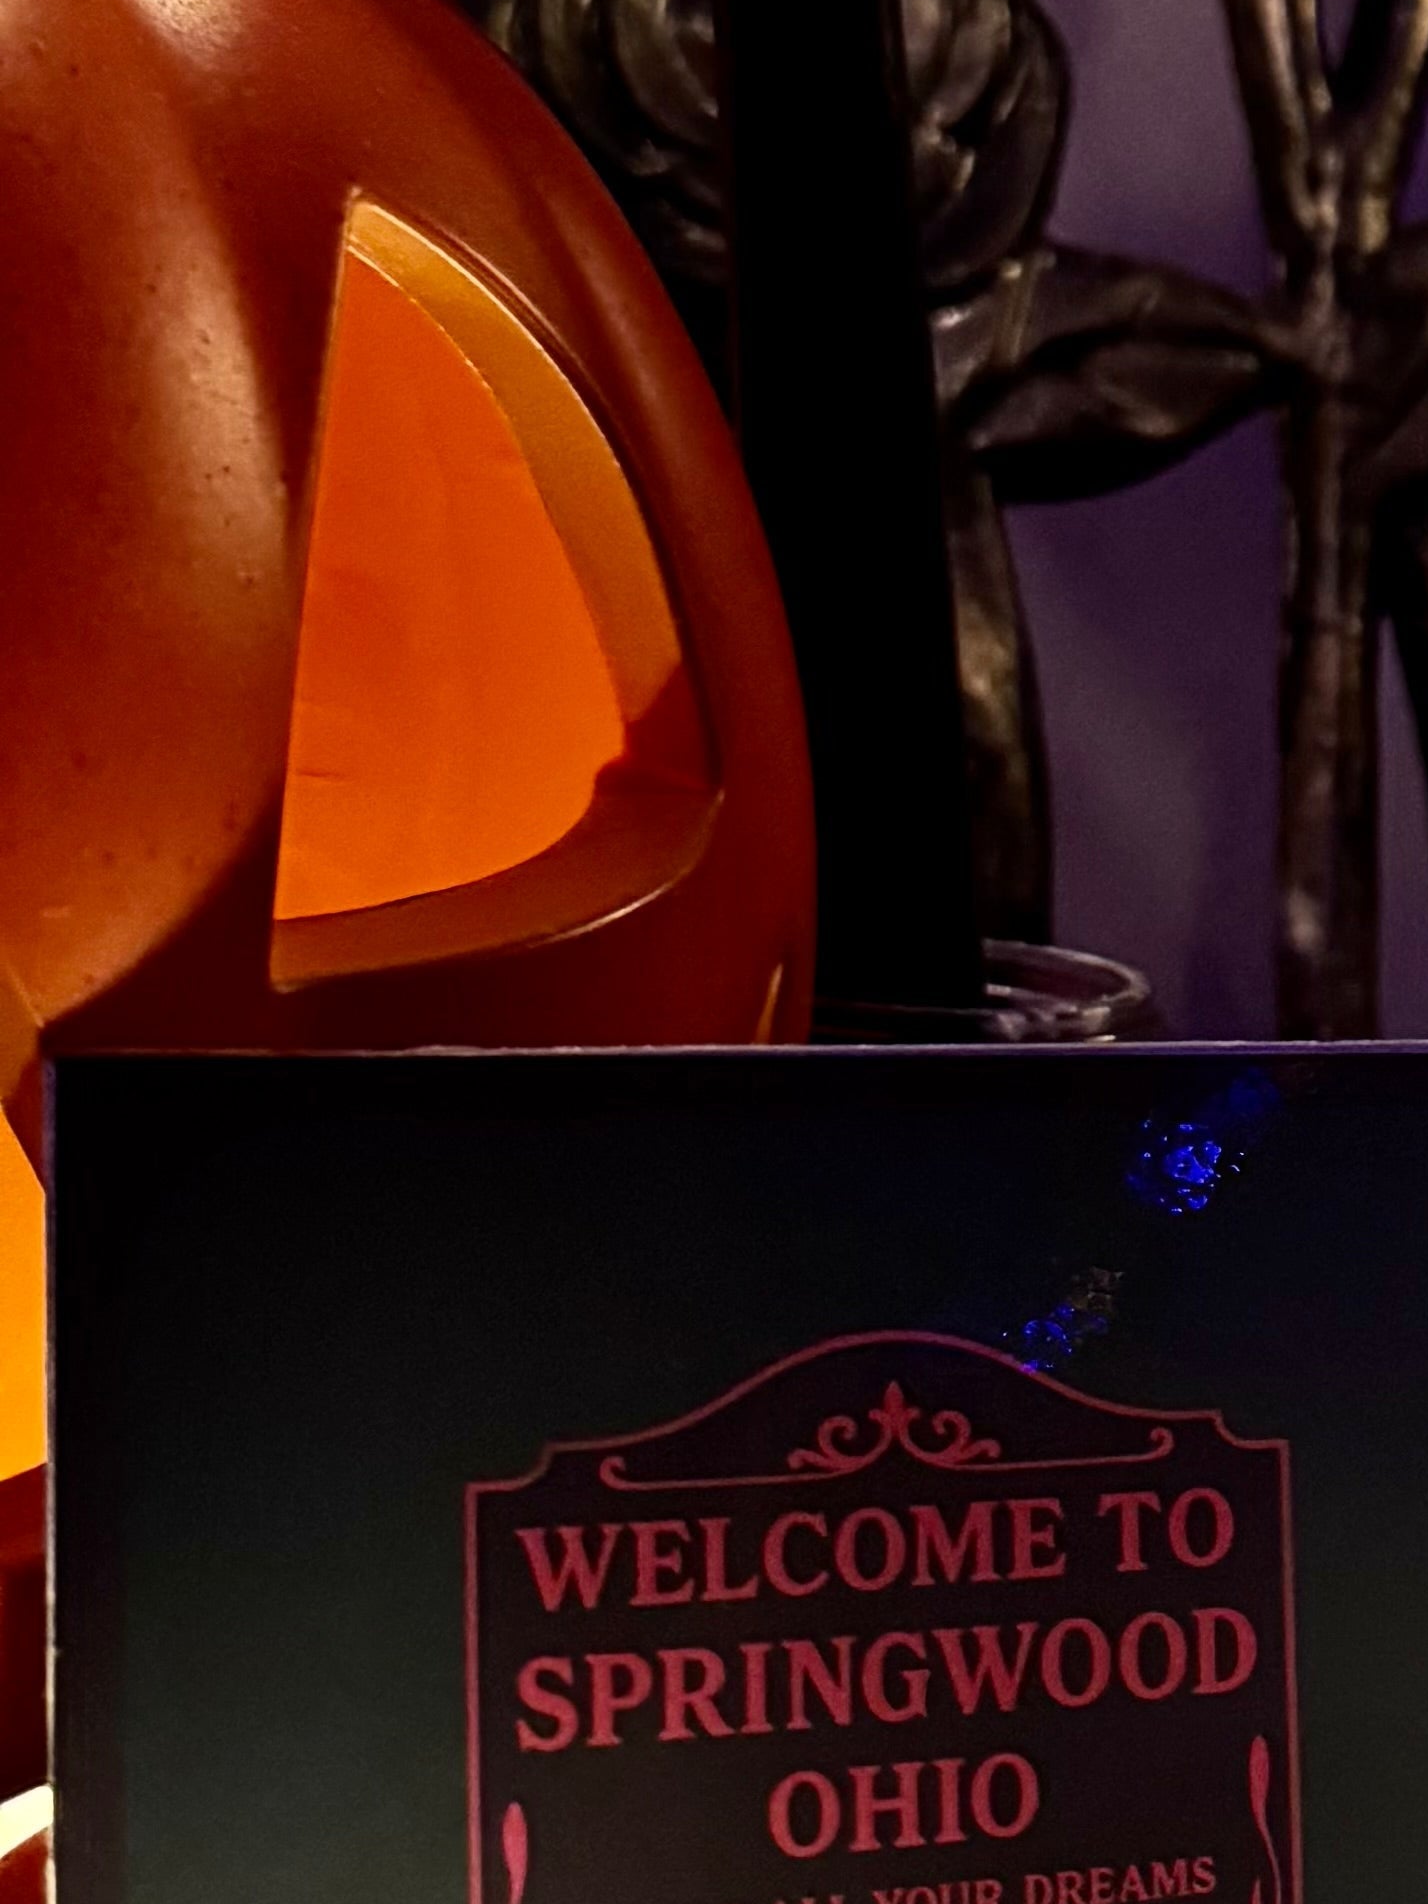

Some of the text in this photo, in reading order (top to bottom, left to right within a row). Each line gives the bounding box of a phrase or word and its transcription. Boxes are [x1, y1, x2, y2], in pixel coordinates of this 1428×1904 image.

[515, 1487, 1236, 1609] WELCOME TO
[515, 1609, 1257, 1752] SPRINGWOOD
[768, 1753, 1037, 1859] OHIO
